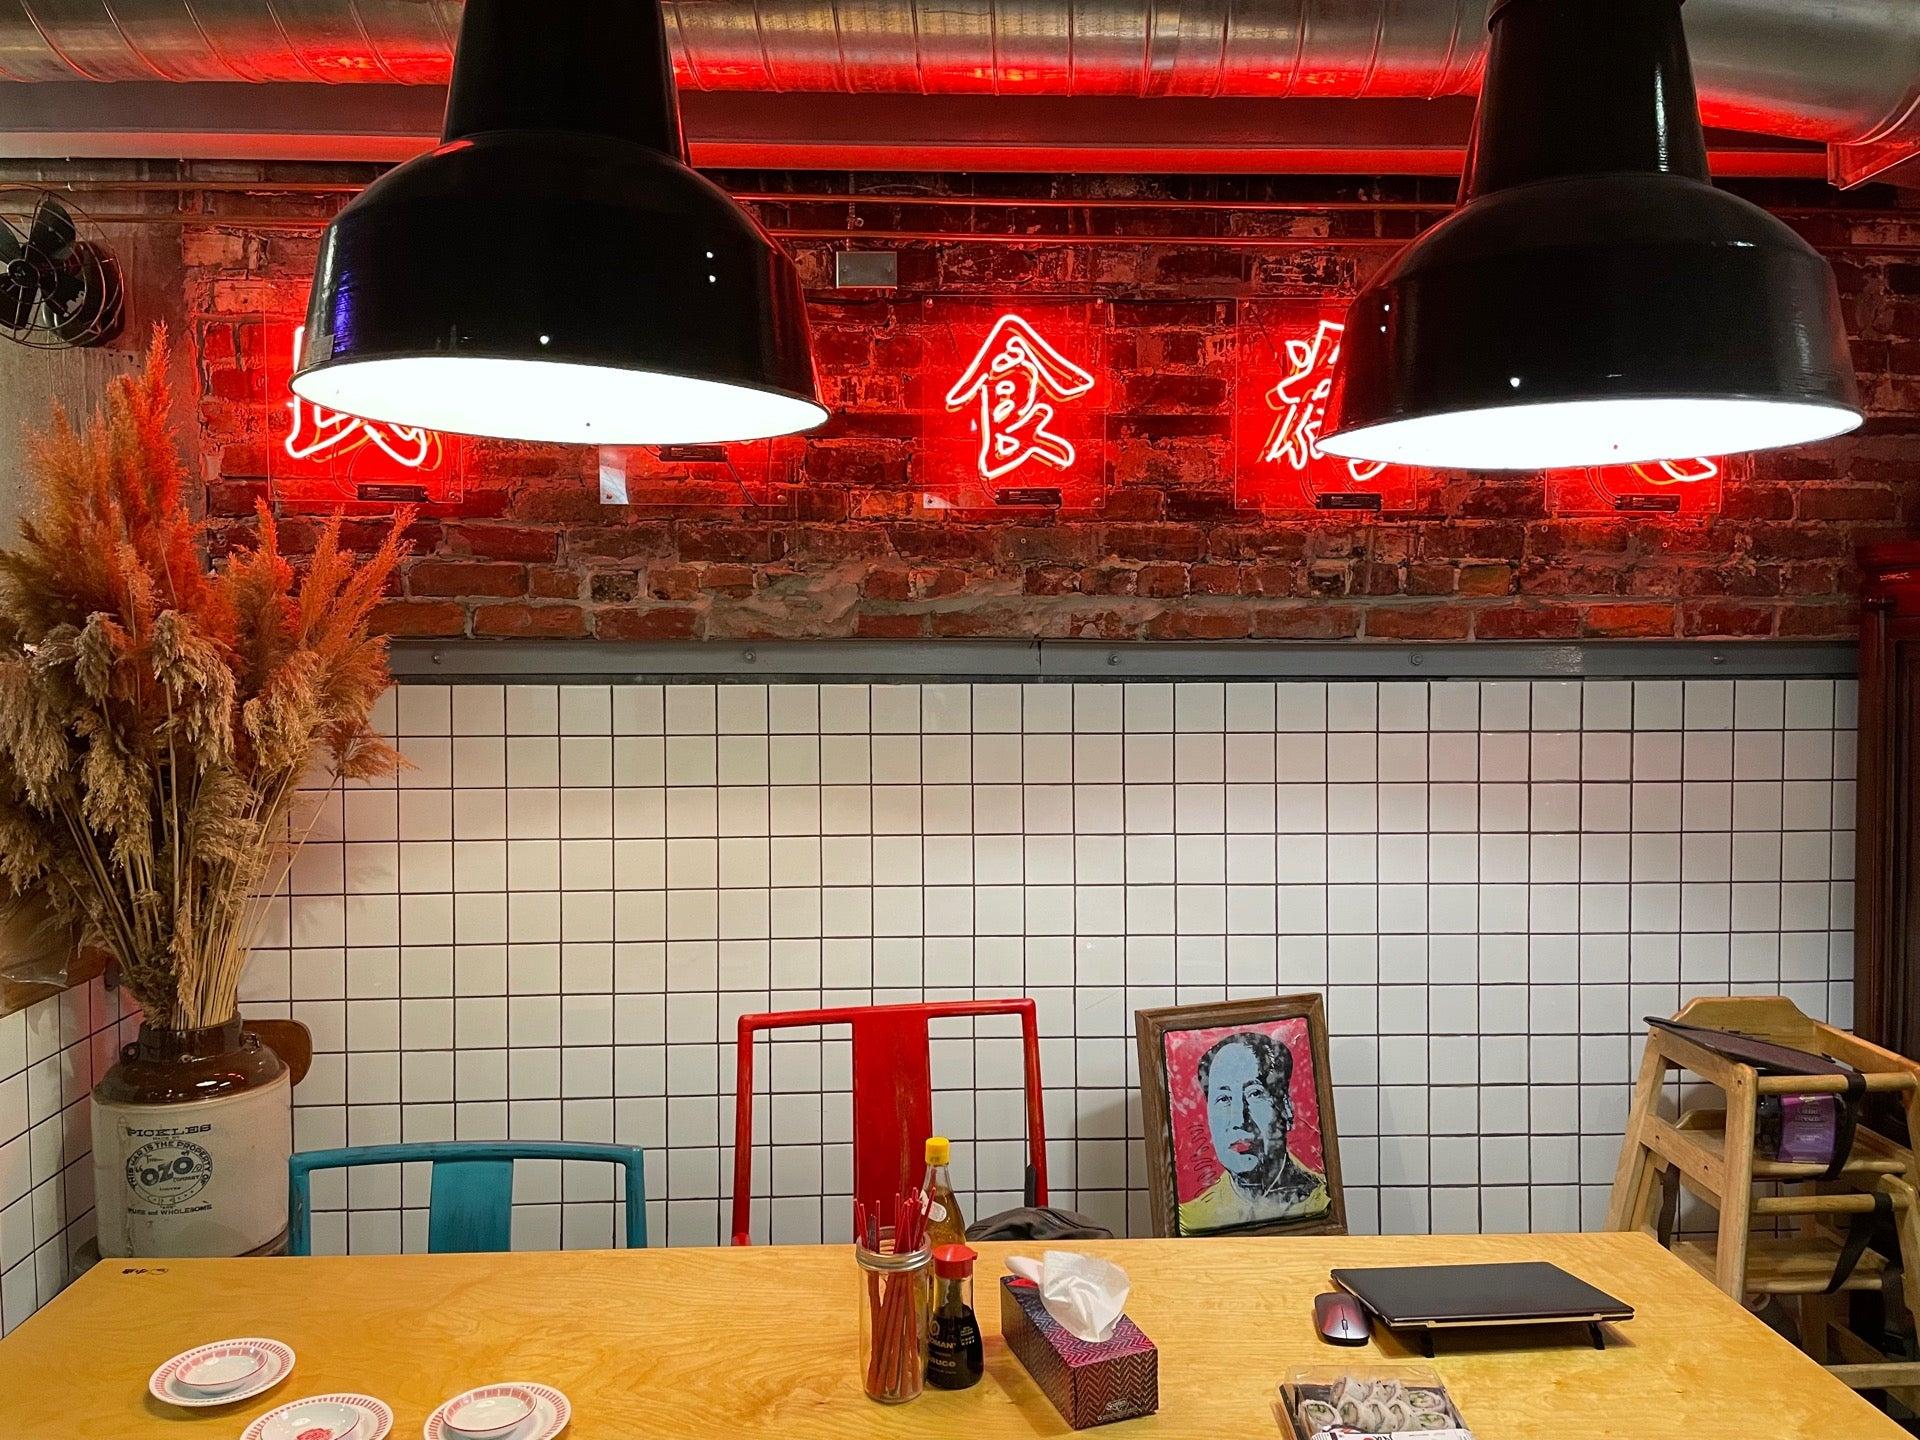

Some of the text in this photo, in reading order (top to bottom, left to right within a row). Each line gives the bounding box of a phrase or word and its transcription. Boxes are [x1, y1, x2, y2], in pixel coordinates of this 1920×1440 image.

[945, 314, 1094, 479] 食
[127, 1124, 212, 1137] PICKLES
[144, 1144, 154, 1153] IS
[154, 1141, 174, 1149] THE
[176, 1141, 211, 1173] PROPERTY
[160, 1204, 213, 1216] WHOLESOME
